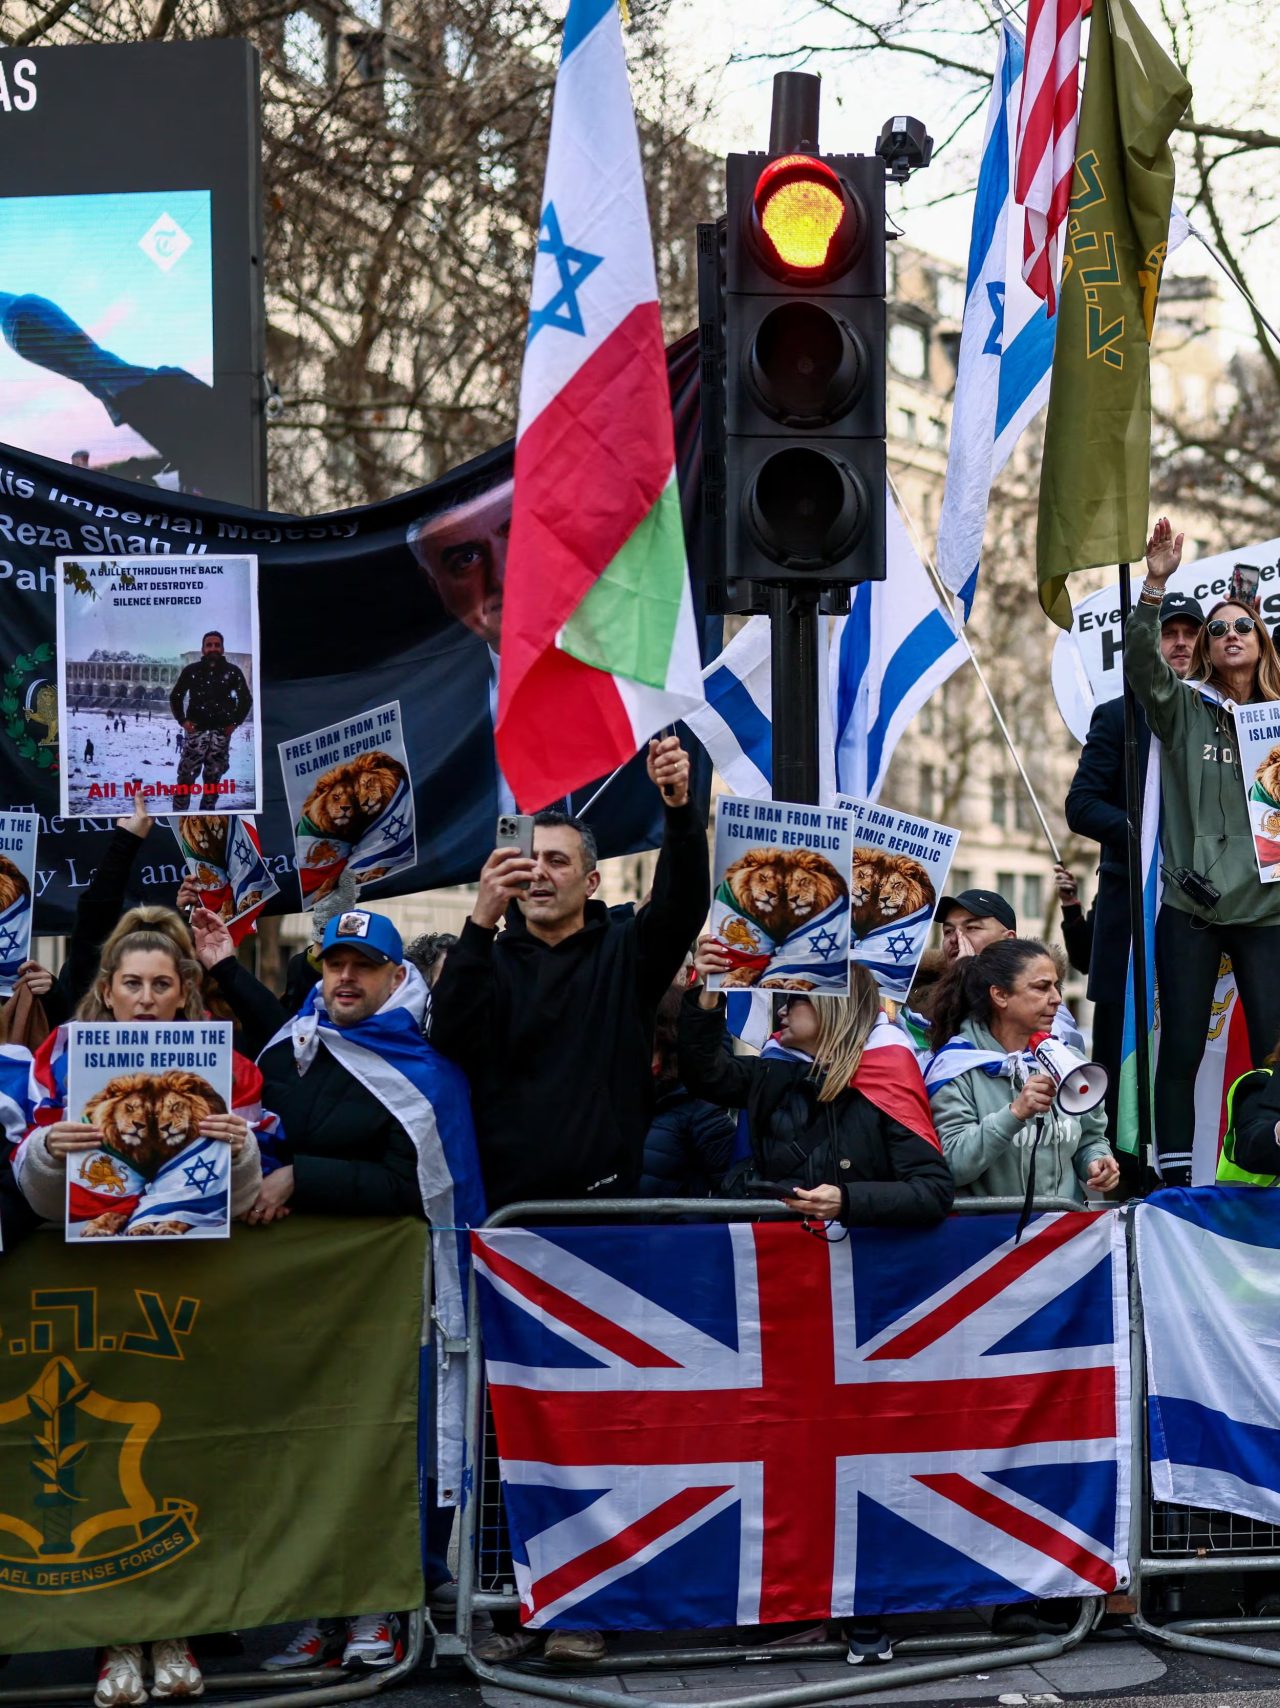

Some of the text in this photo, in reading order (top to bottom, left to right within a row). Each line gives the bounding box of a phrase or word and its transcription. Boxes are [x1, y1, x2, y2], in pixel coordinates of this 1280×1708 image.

[0, 467, 35, 499] is
[48, 487, 202, 535] Imperial
[81, 525, 171, 555] Shah
[90, 565, 224, 577] A BULLET THROUGH THE BACK
[110, 581, 204, 592] A HEART DESTROYED
[113, 596, 202, 607] SILENCE ENFORCED
[1079, 608, 1121, 633] Eve
[1240, 707, 1266, 724] FREE
[286, 709, 396, 760] FREE IRAN FROM THE
[295, 730, 392, 776] ISLAMIC REPUBLIC
[124, 779, 236, 797] Mahmoudi
[11, 819, 32, 833] THE
[722, 801, 848, 831] FREE IRAN FROM THE
[867, 807, 894, 829] IRAN
[897, 818, 929, 840] FROM
[932, 831, 953, 847] THE
[728, 823, 840, 850] ISLAMIC REPUBLIC
[855, 826, 941, 862] AMIC REPUBLIC
[77, 1029, 226, 1046] FREE IRAN FROM THE
[85, 1051, 217, 1069] ISLAMIC REPUBLIC
[8, 1287, 201, 1361] צ.ה.
[37, 1562, 118, 1586] DEFENSE
[120, 1531, 185, 1572] FORCES
